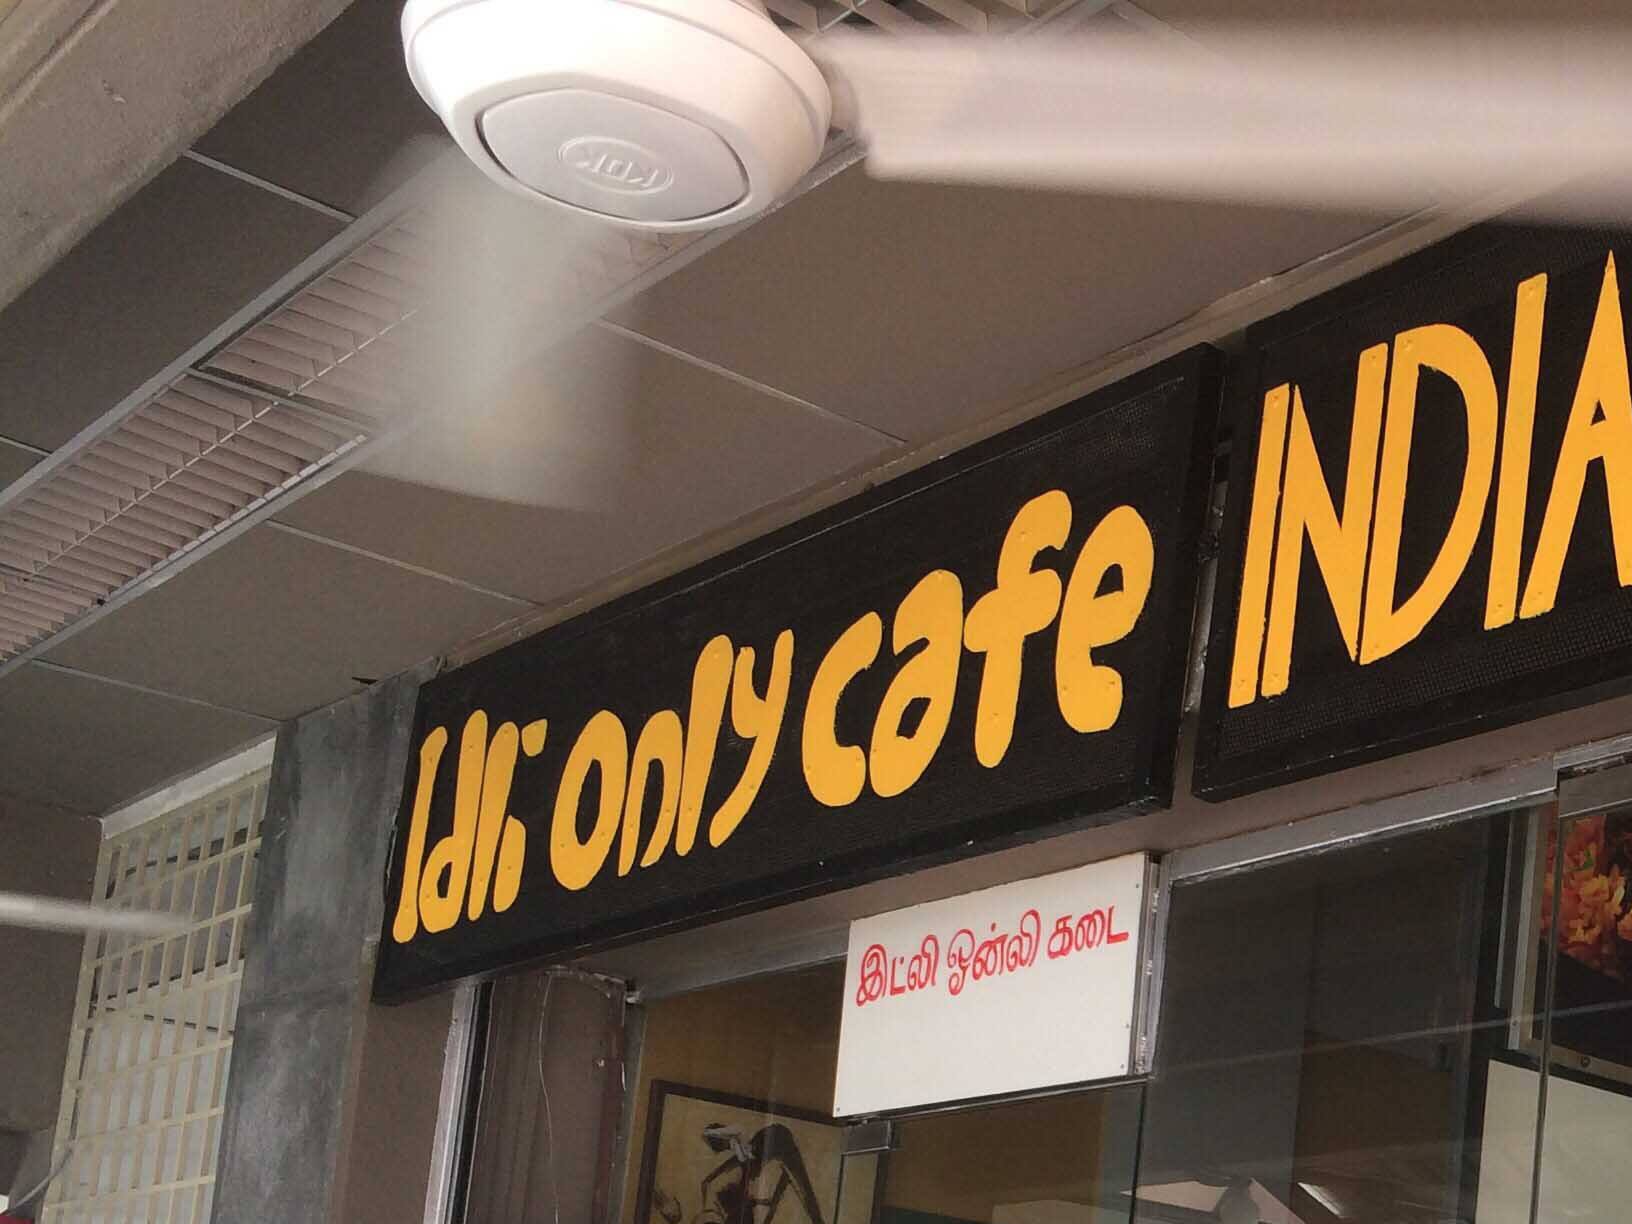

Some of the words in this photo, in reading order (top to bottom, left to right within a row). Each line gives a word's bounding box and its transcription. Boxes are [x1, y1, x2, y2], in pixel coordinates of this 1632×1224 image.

[393, 709, 548, 943] Idli
[550, 628, 793, 890] only
[802, 489, 1155, 807] cafe
[855, 934, 939, 1007] இட்லி
[1048, 905, 1129, 960] கடை
